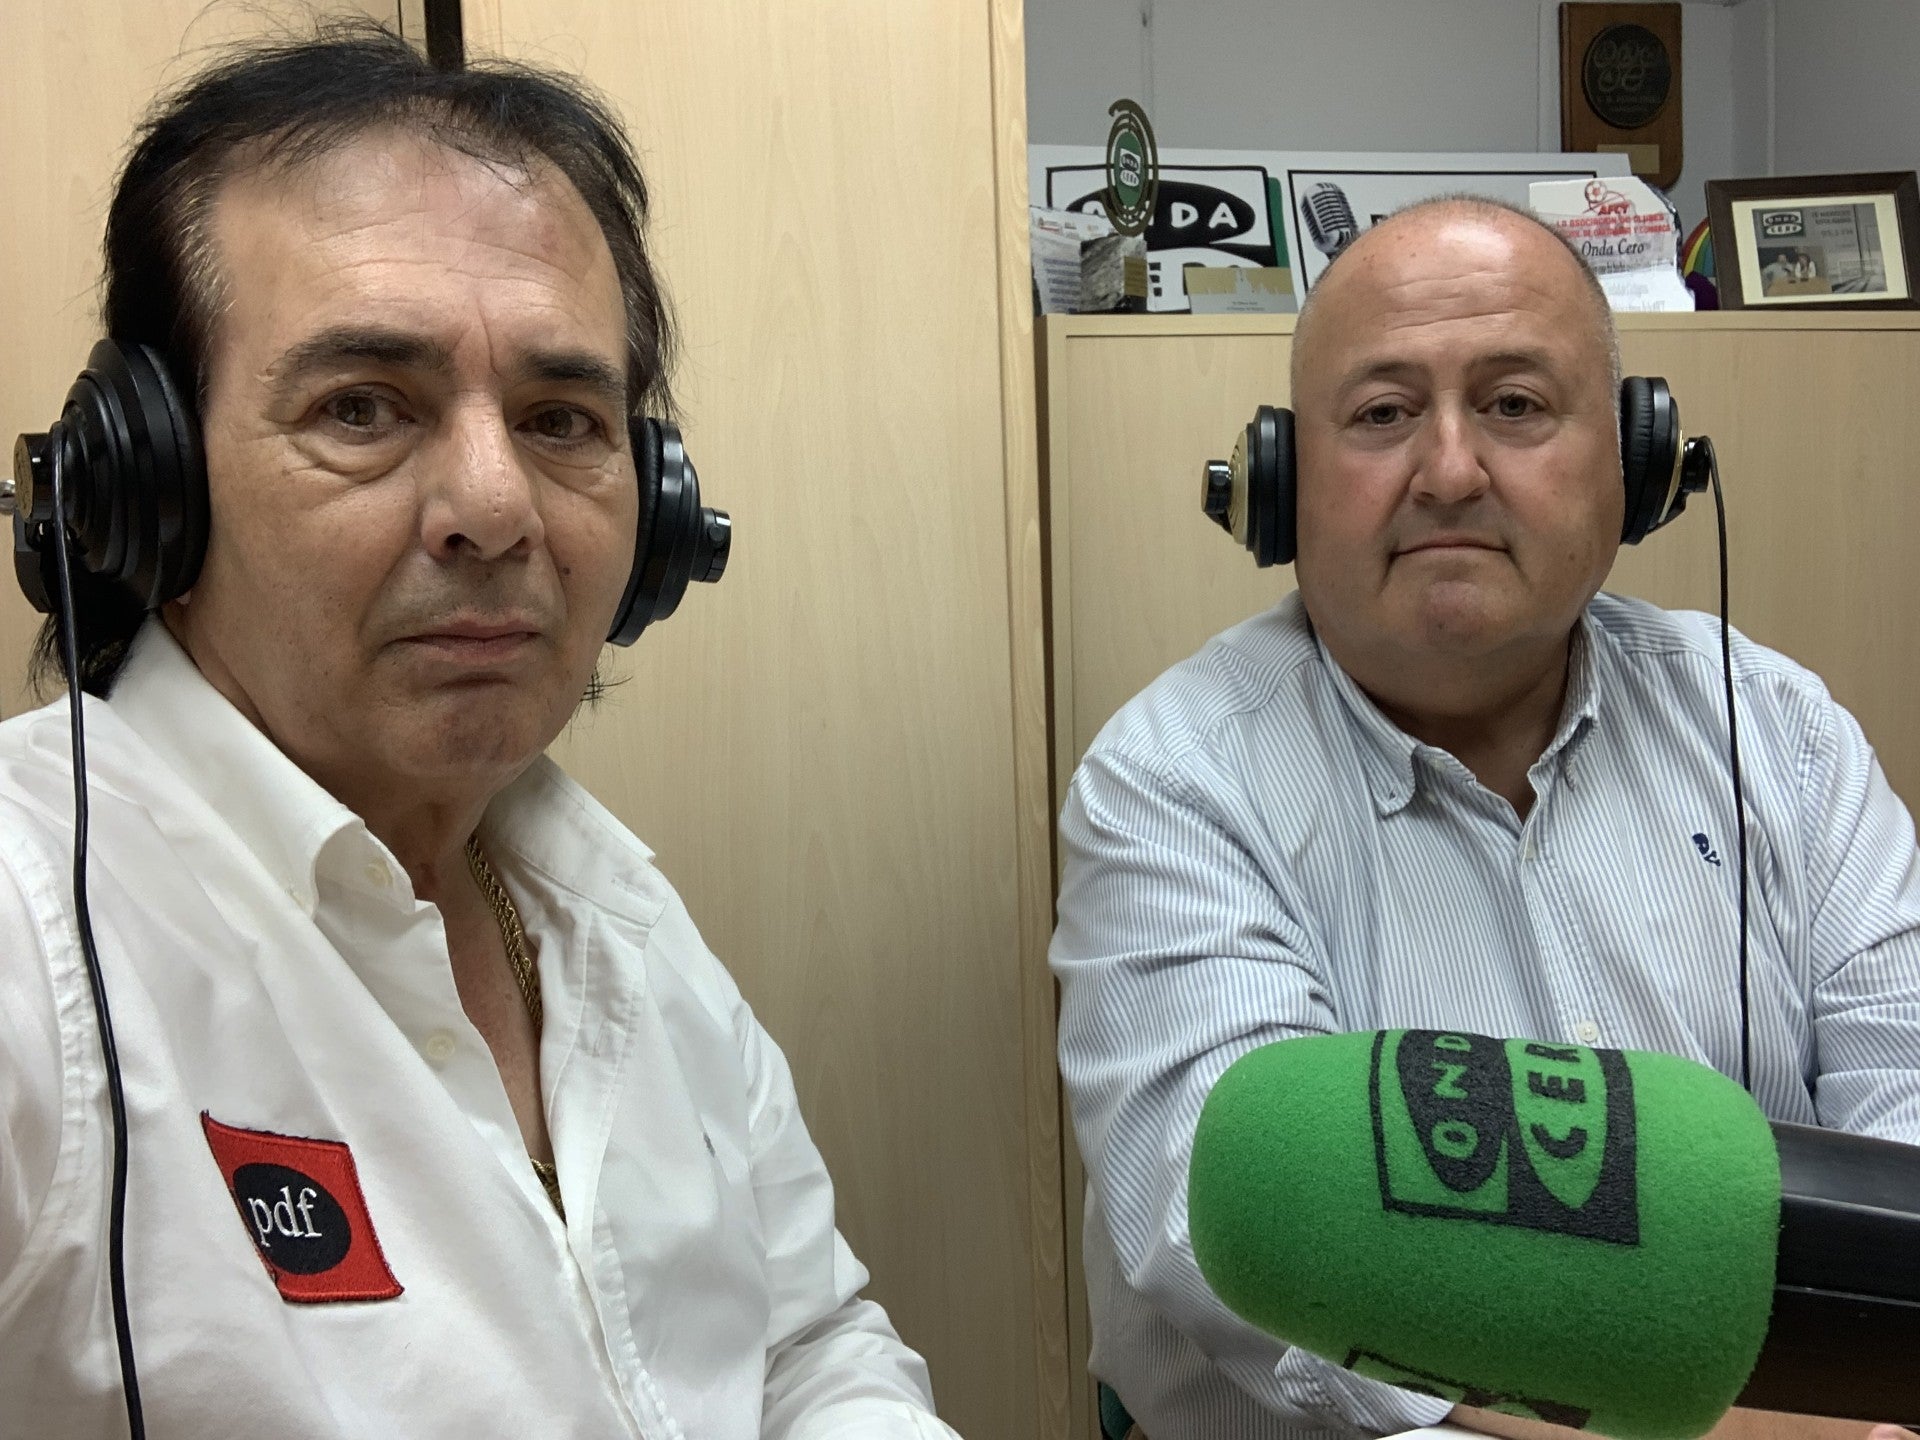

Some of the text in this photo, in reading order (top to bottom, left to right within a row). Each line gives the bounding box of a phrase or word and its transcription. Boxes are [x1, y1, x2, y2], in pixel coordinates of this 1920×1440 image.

[1581, 238, 1645, 257] Onda Cero
[247, 1185, 323, 1247] pdf
